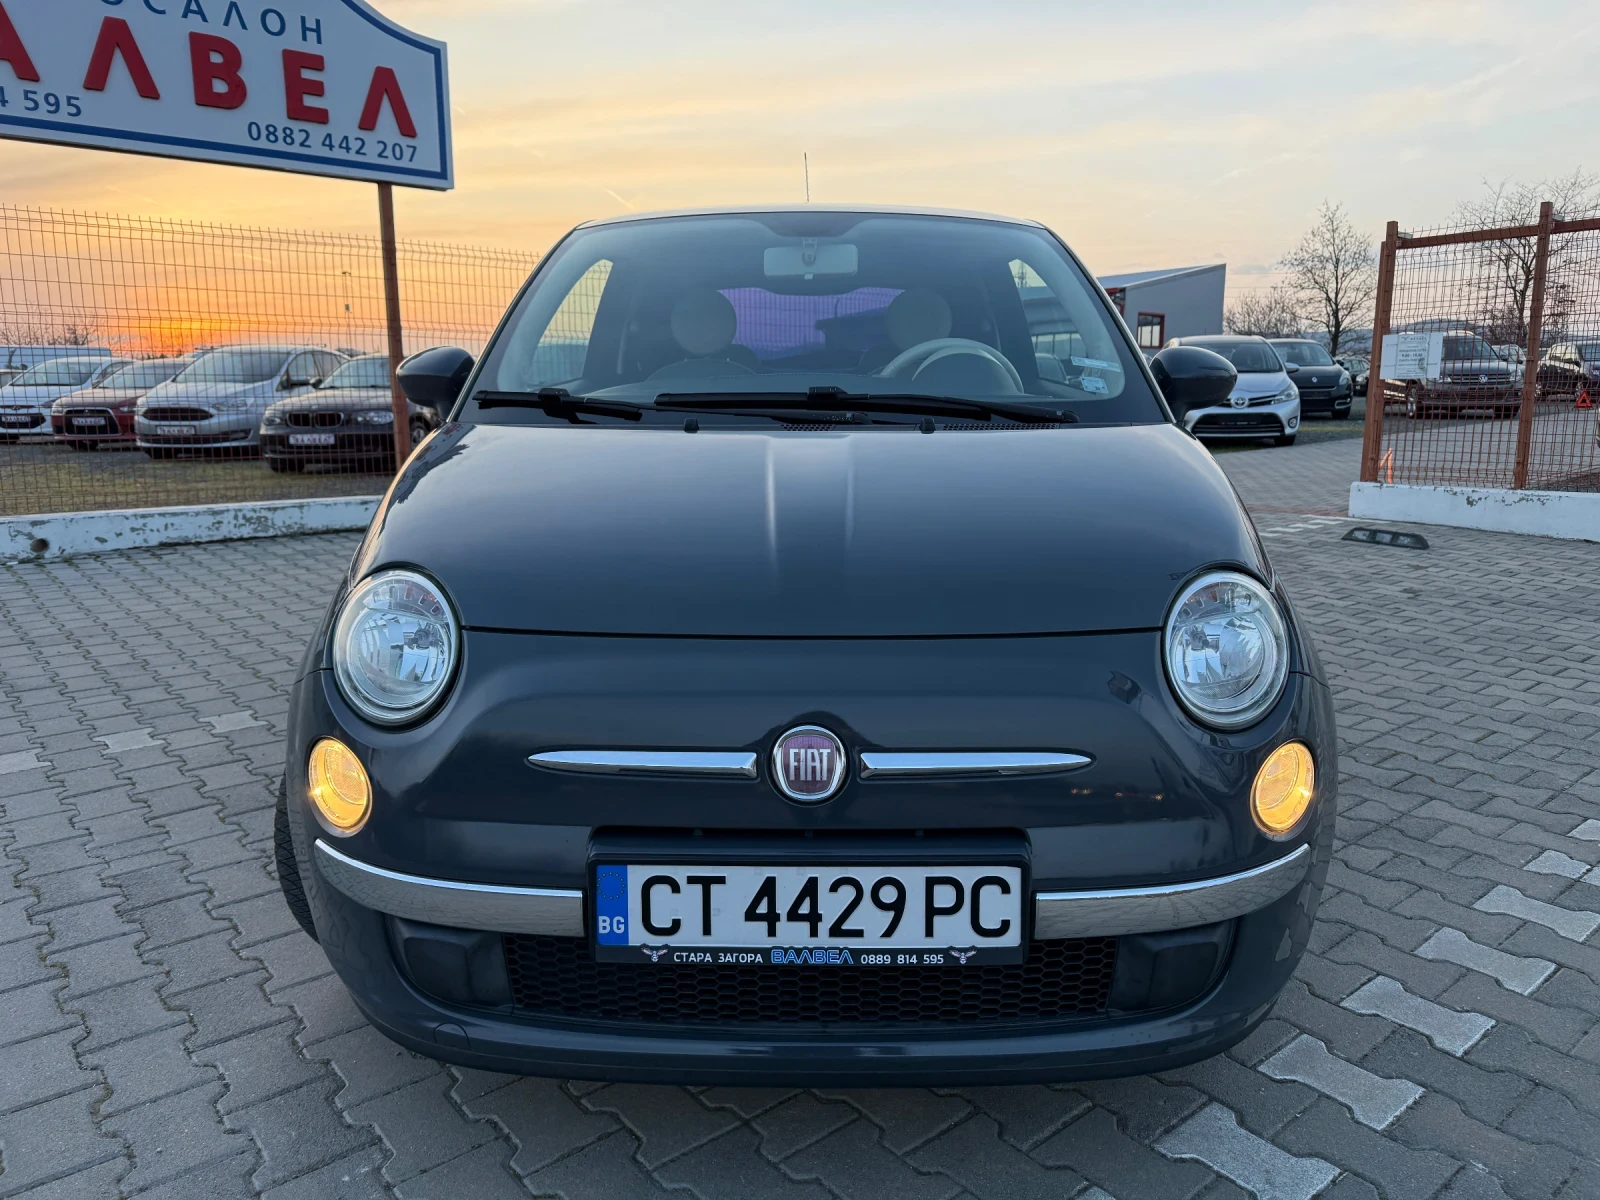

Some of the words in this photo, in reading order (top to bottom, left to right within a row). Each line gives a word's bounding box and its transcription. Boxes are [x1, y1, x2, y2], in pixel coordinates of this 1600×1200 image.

[23, 89, 82, 117] 595
[247, 121, 312, 148] 0882
[321, 133, 367, 156] 442
[377, 140, 417, 162] 207
[789, 748, 831, 781] FIAT
[641, 875, 727, 937] CT
[744, 876, 907, 938] 4429
[925, 876, 1011, 938] PC
[598, 916, 625, 934] BG
[673, 952, 713, 963] СТАРА
[718, 952, 763, 964] ЗАГОРА
[860, 954, 891, 965] 0889
[897, 954, 918, 965] 814
[923, 954, 944, 965] 595
